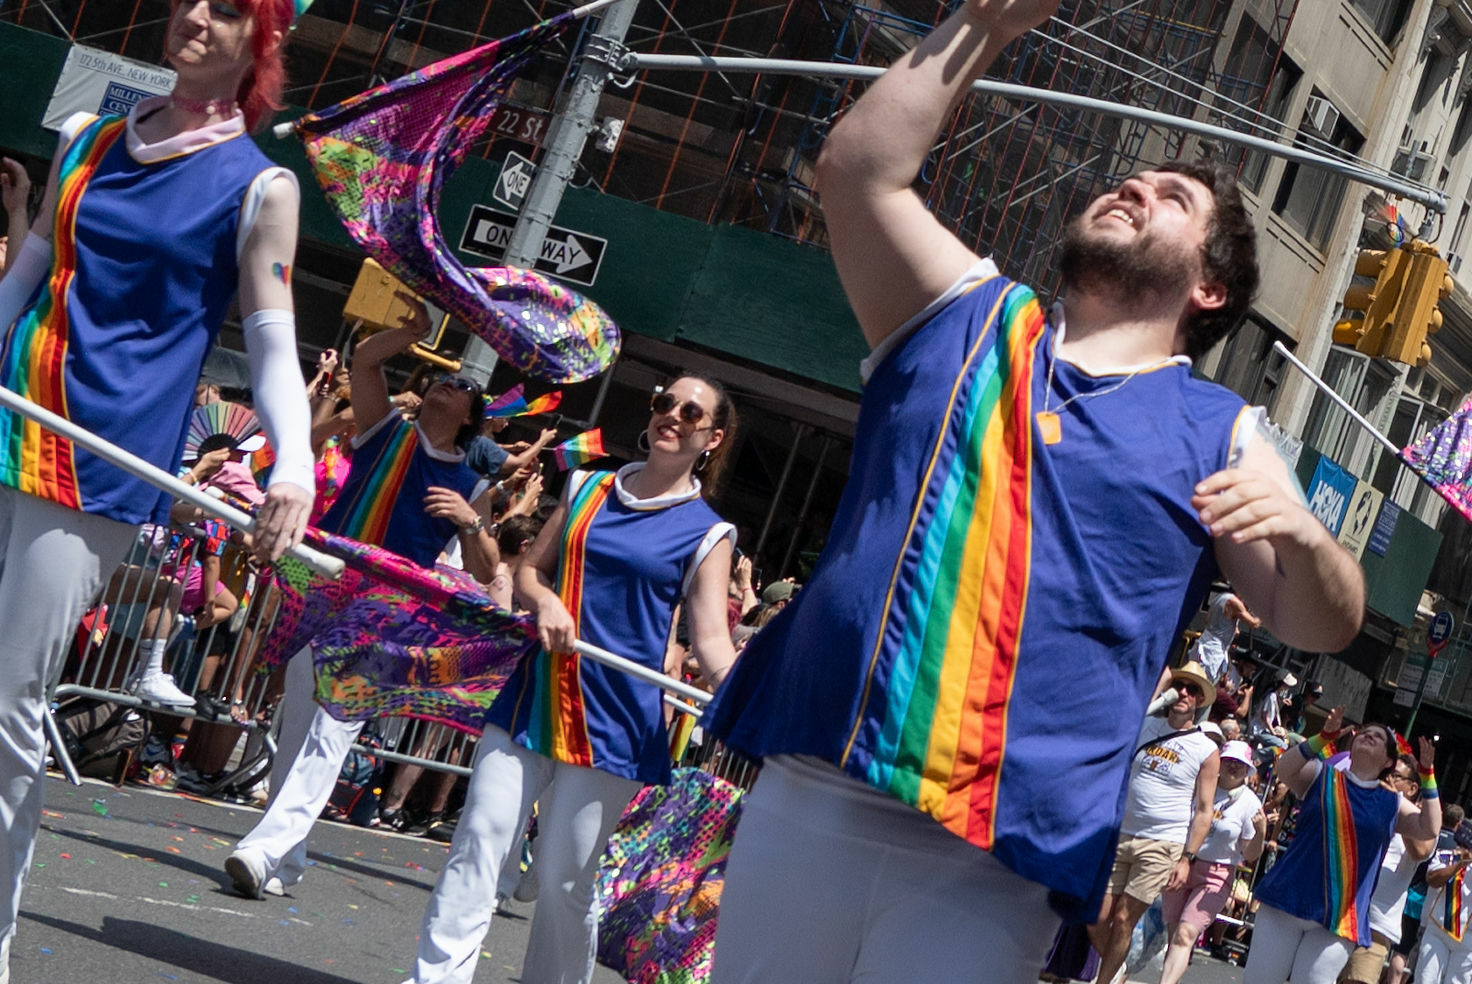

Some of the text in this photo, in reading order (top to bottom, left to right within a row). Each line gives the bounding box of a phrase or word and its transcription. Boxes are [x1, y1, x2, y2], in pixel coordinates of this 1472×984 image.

[92, 57, 106, 71] 5th
[127, 68, 149, 81] NEW
[497, 110, 543, 141] 22 St
[507, 171, 528, 195] ONE
[486, 225, 582, 265] ON WAY
